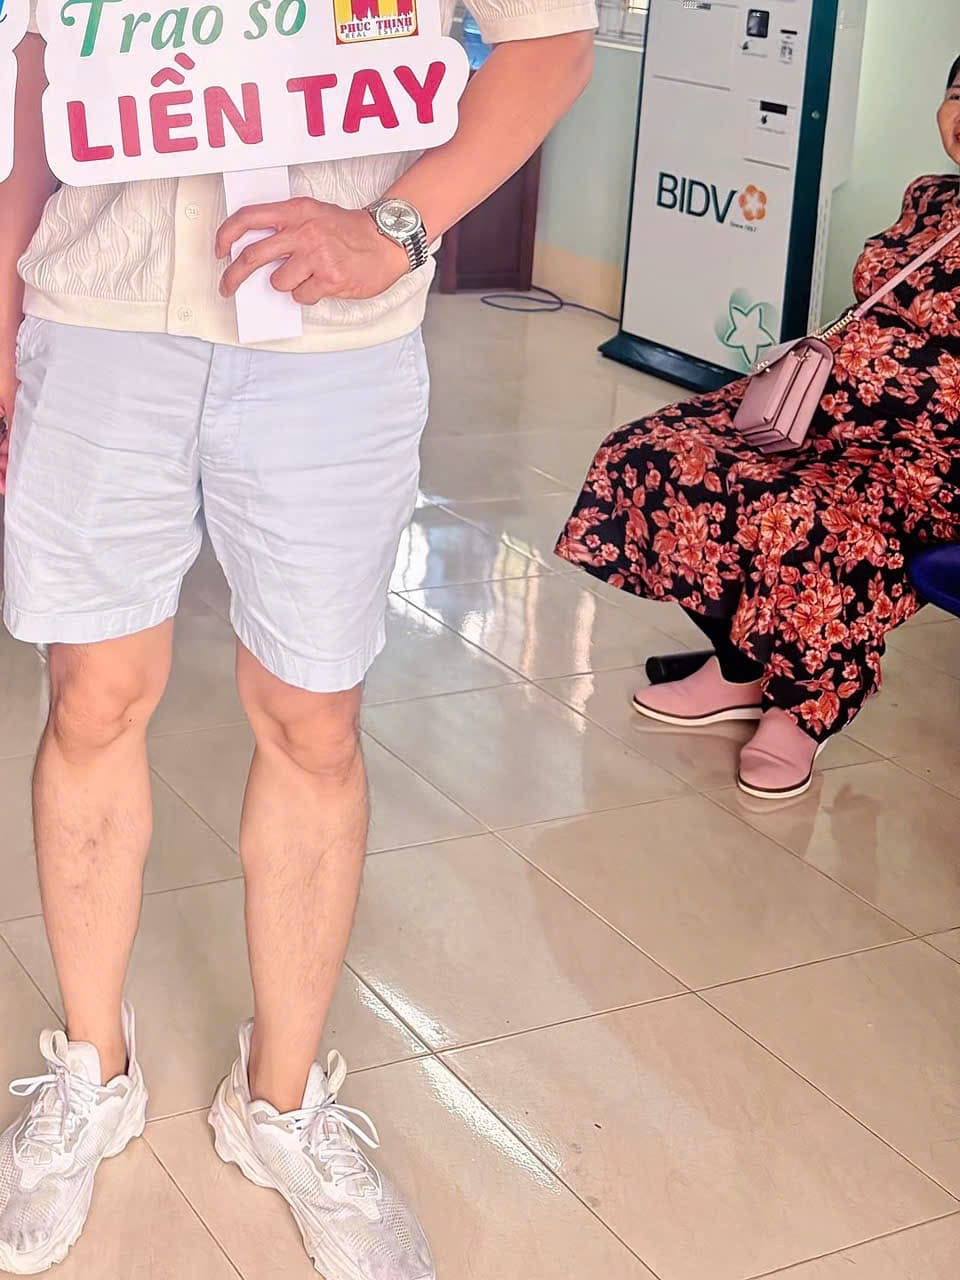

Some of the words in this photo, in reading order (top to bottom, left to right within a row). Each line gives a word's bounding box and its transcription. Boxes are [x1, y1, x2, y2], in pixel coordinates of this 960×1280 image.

[345, 31, 367, 39] REAL
[378, 26, 411, 36] ESTATE
[67, 52, 264, 163] LIỀN
[286, 60, 447, 138] TAY
[656, 171, 738, 224] BIDV
